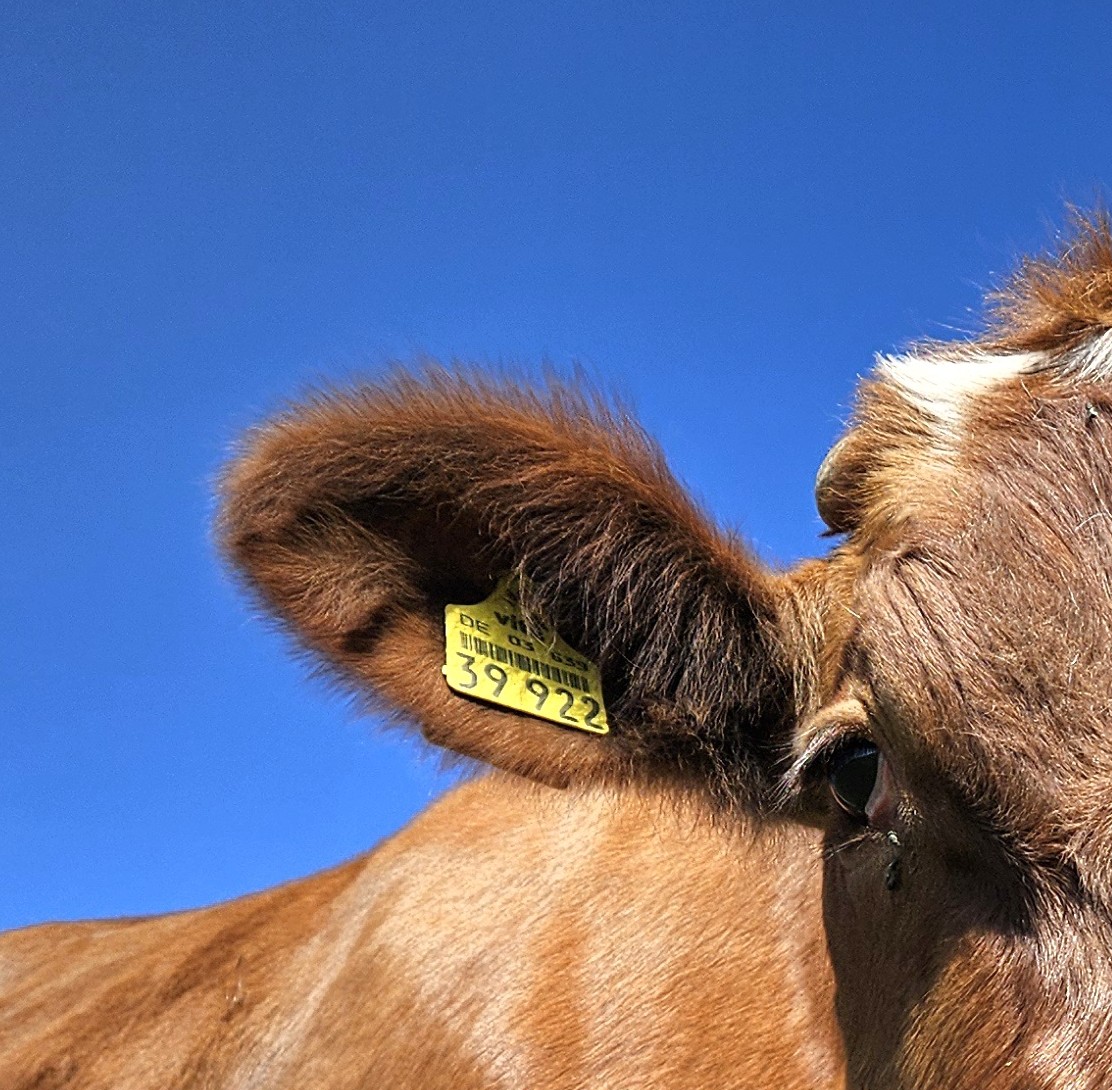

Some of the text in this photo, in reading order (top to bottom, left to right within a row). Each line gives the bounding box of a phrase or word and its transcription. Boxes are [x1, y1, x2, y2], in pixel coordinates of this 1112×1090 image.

[459, 613, 490, 636] DE
[456, 651, 605, 730] 39 922
